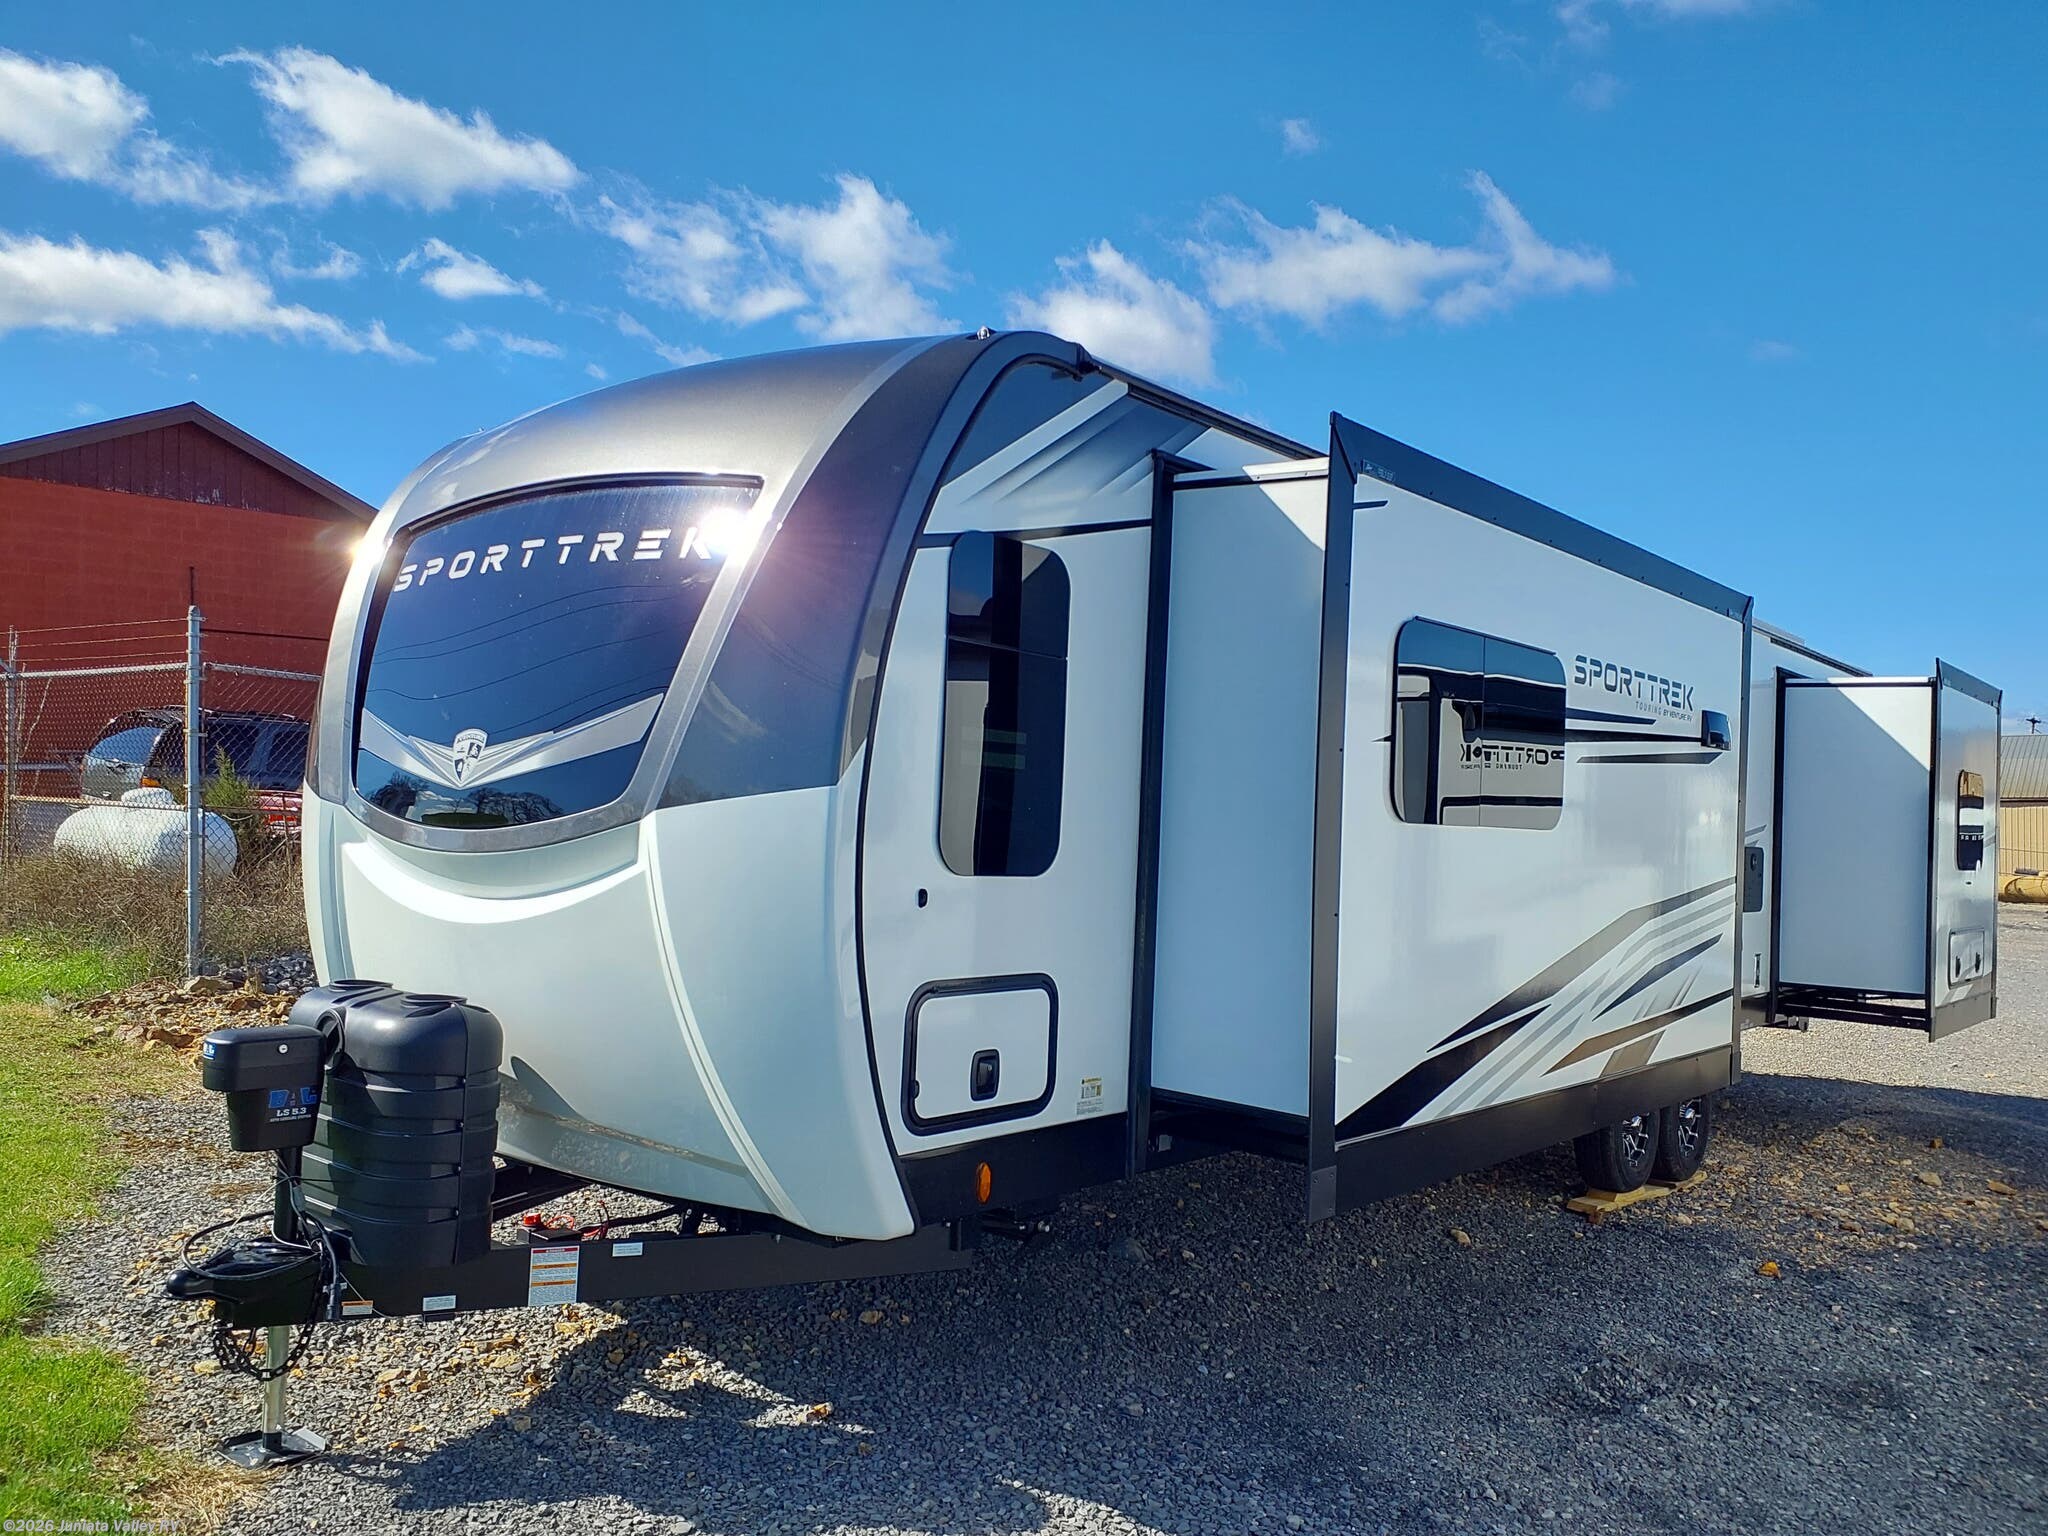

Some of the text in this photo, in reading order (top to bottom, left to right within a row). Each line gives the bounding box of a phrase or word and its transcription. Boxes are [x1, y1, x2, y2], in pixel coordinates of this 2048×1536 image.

[393, 526, 714, 592] SPORTTREK
[1574, 655, 1694, 711] SPORTTREK
[1635, 701, 1662, 716] TOURING
[276, 1108, 290, 1117] LS
